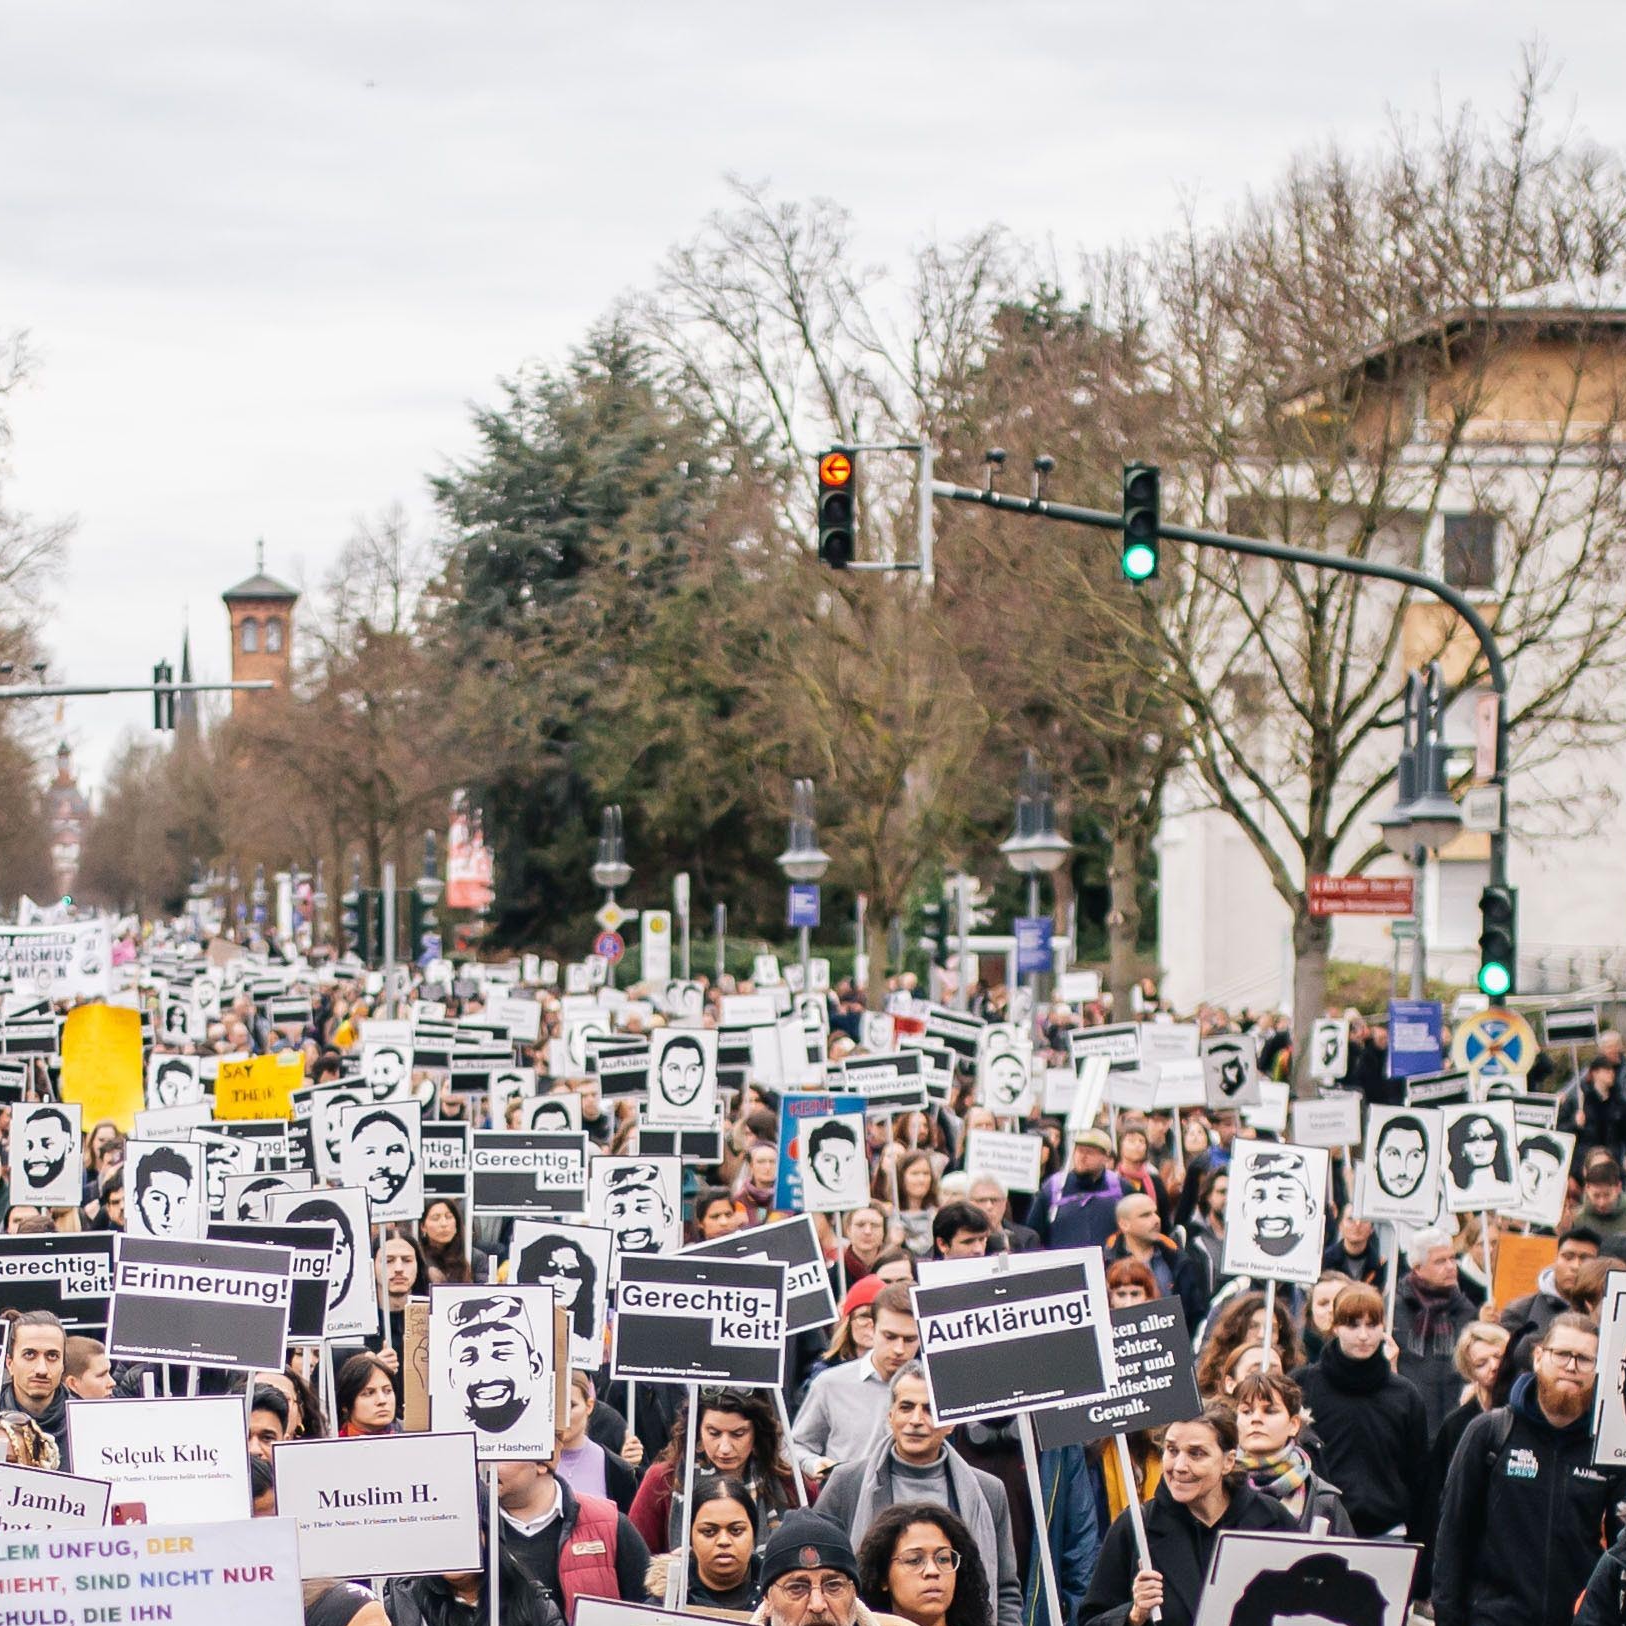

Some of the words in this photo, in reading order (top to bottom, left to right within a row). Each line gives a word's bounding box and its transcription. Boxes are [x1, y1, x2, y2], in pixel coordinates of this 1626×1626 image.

[223, 1064, 254, 1079] SAY
[429, 1155, 466, 1169] keit!
[476, 1152, 579, 1171] Gerechtig-
[543, 1168, 585, 1185] keit!
[66, 1275, 114, 1293] keit!
[121, 1266, 288, 1304] Erinnerung!
[622, 1285, 772, 1318] Gerechtig-
[719, 1317, 780, 1341] keit!
[927, 1294, 1093, 1345] Aufklärung!
[1139, 1313, 1176, 1334] aller
[1145, 1352, 1176, 1373] und
[1089, 1398, 1151, 1424] Gewalt.
[101, 1446, 166, 1469] Selçuk
[171, 1443, 220, 1468] Kılıç
[498, 1442, 544, 1453] Hashemi
[8, 1485, 87, 1518] Jamba
[317, 1486, 404, 1510] Muslim
[411, 1483, 439, 1504] H.
[48, 1539, 139, 1562] UNFUG,
[146, 1535, 195, 1556] DER
[75, 1572, 132, 1592] SIND
[140, 1568, 214, 1589] NICHT
[222, 1564, 275, 1584] NUR
[83, 1605, 123, 1625] DIE
[129, 1602, 174, 1622] IHN
